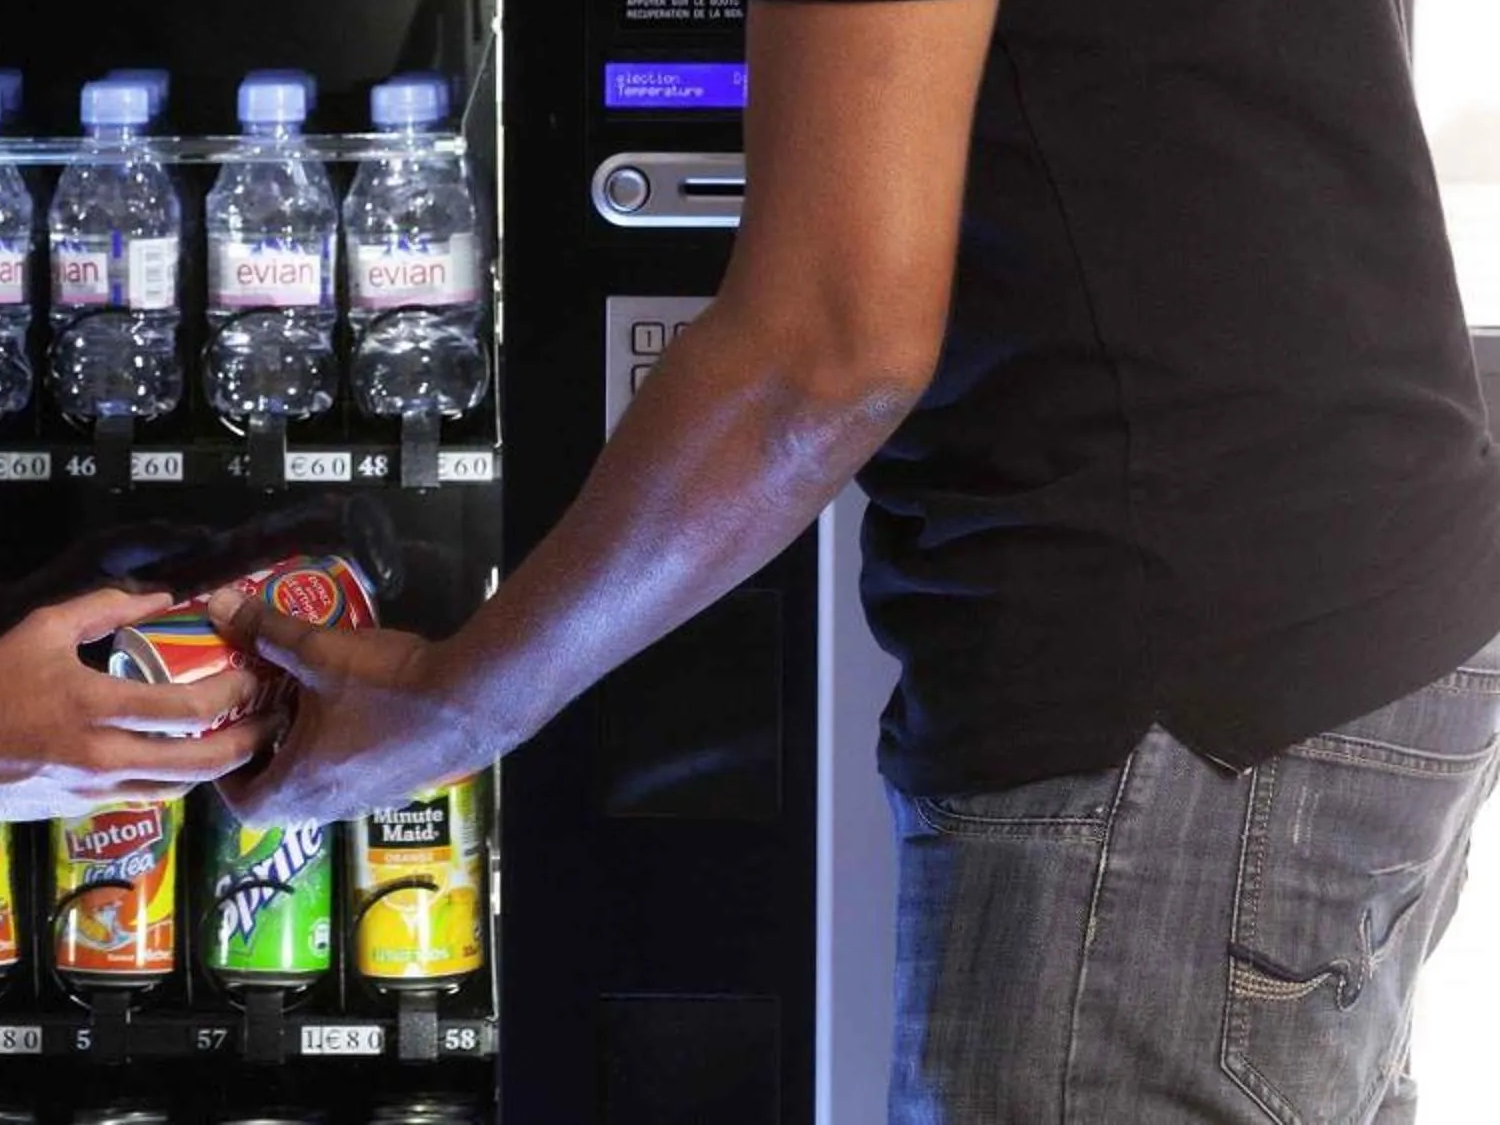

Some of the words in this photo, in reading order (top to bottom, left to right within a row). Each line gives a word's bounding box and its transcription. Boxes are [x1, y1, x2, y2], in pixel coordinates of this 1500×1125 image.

[236, 261, 315, 285] evian
[368, 261, 447, 287] evian
[65, 455, 97, 476] 46
[291, 456, 347, 477] €60
[357, 454, 389, 476] 48
[373, 806, 445, 825] Minute
[67, 817, 155, 857] Lipton
[383, 824, 435, 843] Maid
[117, 849, 156, 879] Tea
[75, 1029, 91, 1050] 5
[197, 1029, 227, 1050] 57
[445, 1029, 476, 1050] 58
